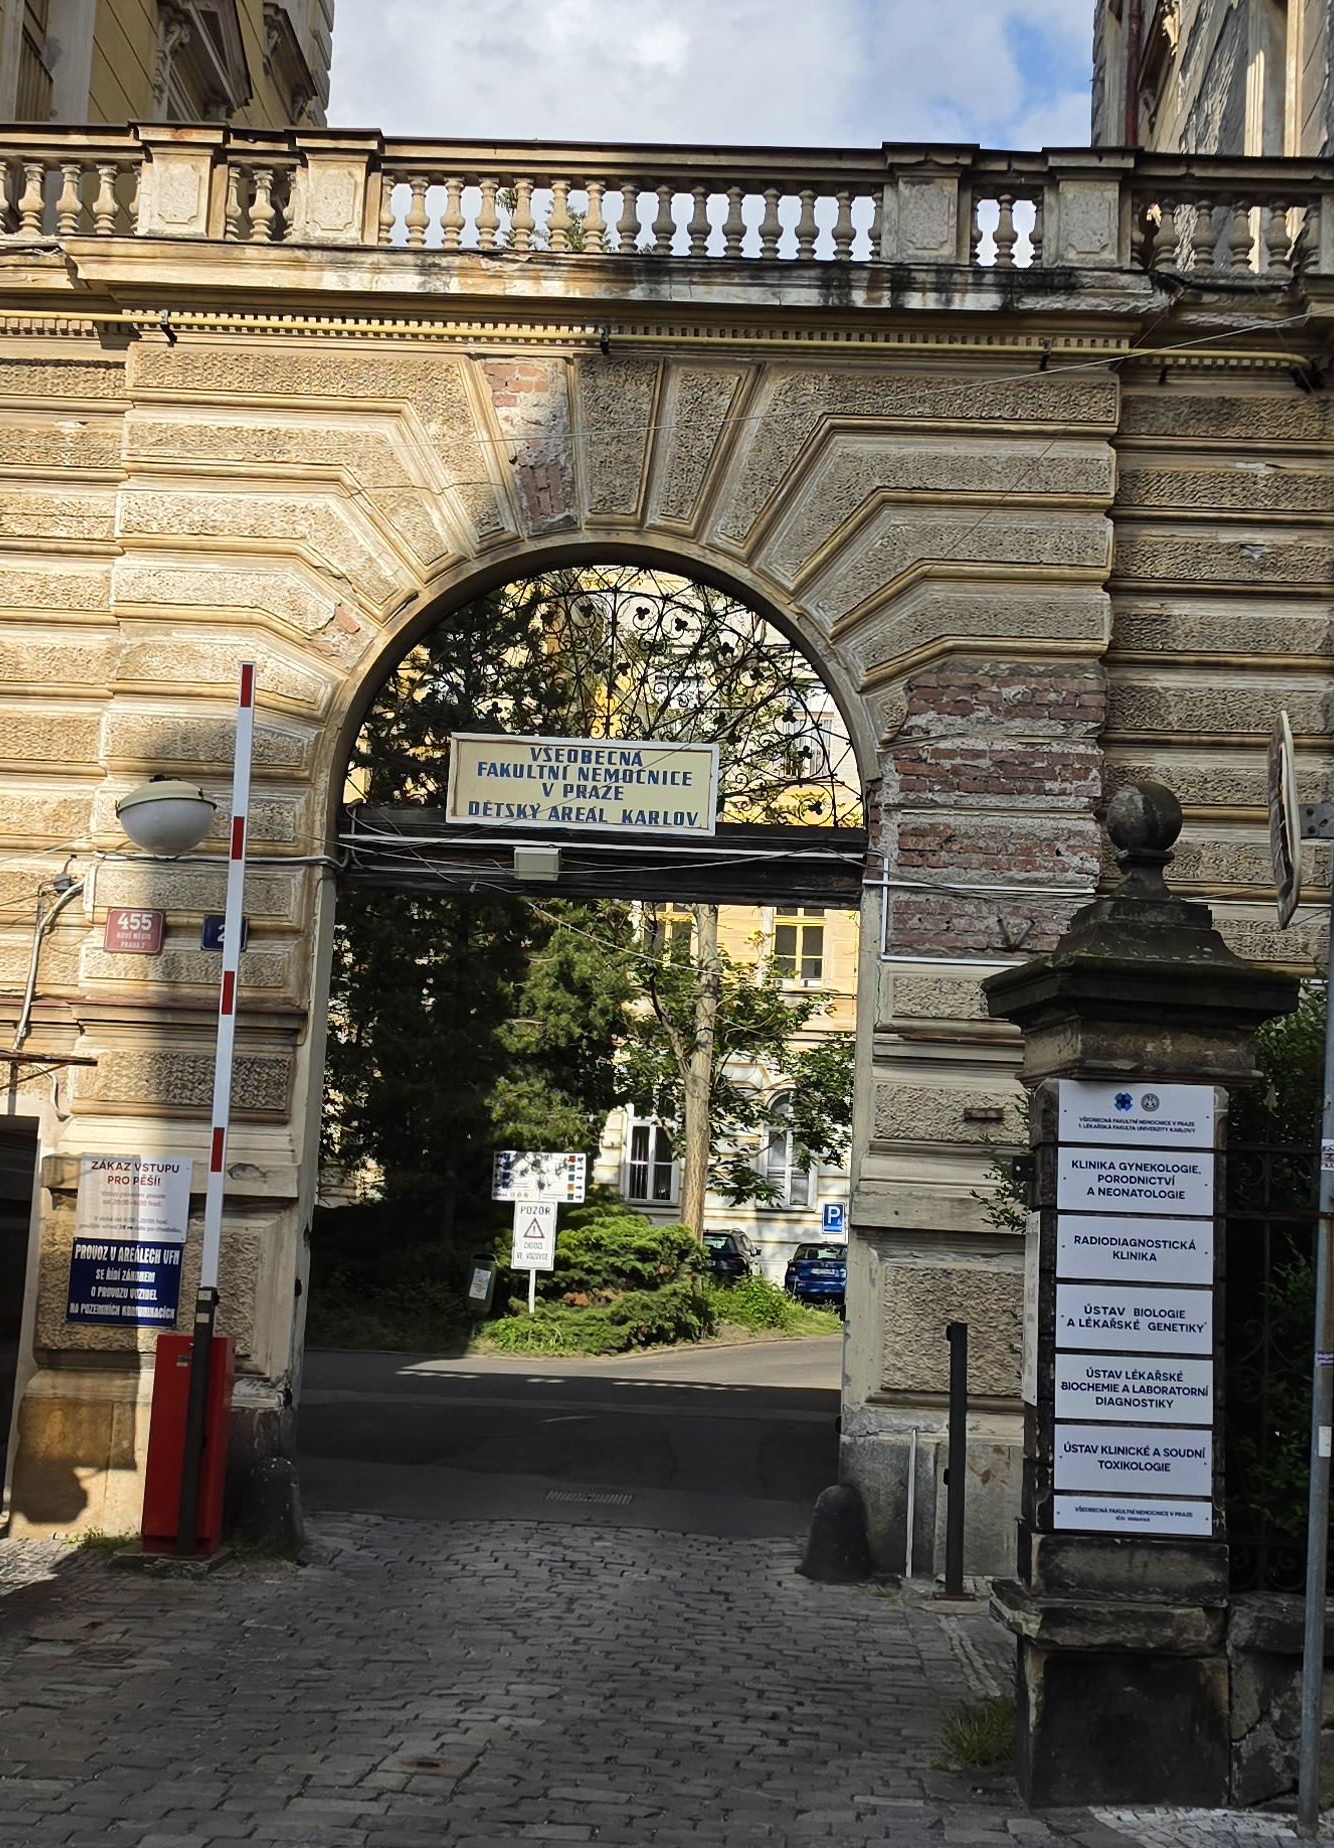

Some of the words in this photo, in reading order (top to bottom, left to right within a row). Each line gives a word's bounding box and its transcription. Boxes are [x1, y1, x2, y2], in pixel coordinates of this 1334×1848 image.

[530, 747, 643, 766] VŠEOBECNÁ
[477, 761, 570, 781] FAKULTNÍ
[578, 766, 693, 787] NEMOCNICE
[542, 782, 553, 798] V
[563, 784, 624, 801] PRAZE
[468, 800, 541, 819] DĚTSKÝ
[548, 806, 608, 823] AREÁL
[622, 809, 699, 827] KARLOV
[117, 912, 153, 931] 455
[90, 1159, 131, 1171] ZÁKAZ
[134, 1163, 180, 1174] VSTUPU
[1071, 1159, 1116, 1171] KLINIKA
[107, 1175, 130, 1185] PRO
[132, 1174, 161, 1187] PĚŠÍ!
[1097, 1174, 1175, 1186] PORODNICTVÍ
[1086, 1187, 1095, 1196] A
[1097, 1188, 1186, 1200] NEONATOLOGIE
[520, 1205, 551, 1215] POZOR
[827, 1205, 841, 1224] P
[1073, 1235, 1196, 1251] RADIODIAGNOSTICKÁ
[74, 1244, 109, 1260] PROVOZ
[118, 1245, 162, 1265] AREÁLECH
[1112, 1251, 1157, 1262] KLINIKA
[95, 1268, 105, 1280] SE
[121, 1268, 156, 1283] ZÁKONEM
[90, 1286, 96, 1297] O
[97, 1286, 129, 1298] PROVOZU
[1084, 1303, 1126, 1317] ÚSTAV
[1133, 1308, 1186, 1319] BIOLOGIE
[1066, 1318, 1075, 1327] A
[1078, 1316, 1140, 1331] LÉKAŘSKÉ
[1147, 1322, 1204, 1333] GENETIKY
[1086, 1366, 1122, 1380] ÚSTAV
[1125, 1369, 1184, 1382] LÉKAŘSKÉ
[1060, 1382, 1119, 1393] BIOCHEMIE
[1122, 1384, 1130, 1393] A
[1132, 1384, 1209, 1397] LABORATORNÍ
[1095, 1396, 1174, 1409] DIAGNOSTIKY
[1063, 1441, 1098, 1454] ÚSTAV
[1100, 1444, 1150, 1457] KLINICKÉ
[1152, 1448, 1161, 1457] A
[1163, 1446, 1206, 1459] SOUDNÍ
[1097, 1460, 1171, 1472] TOXIKOLOGIE
